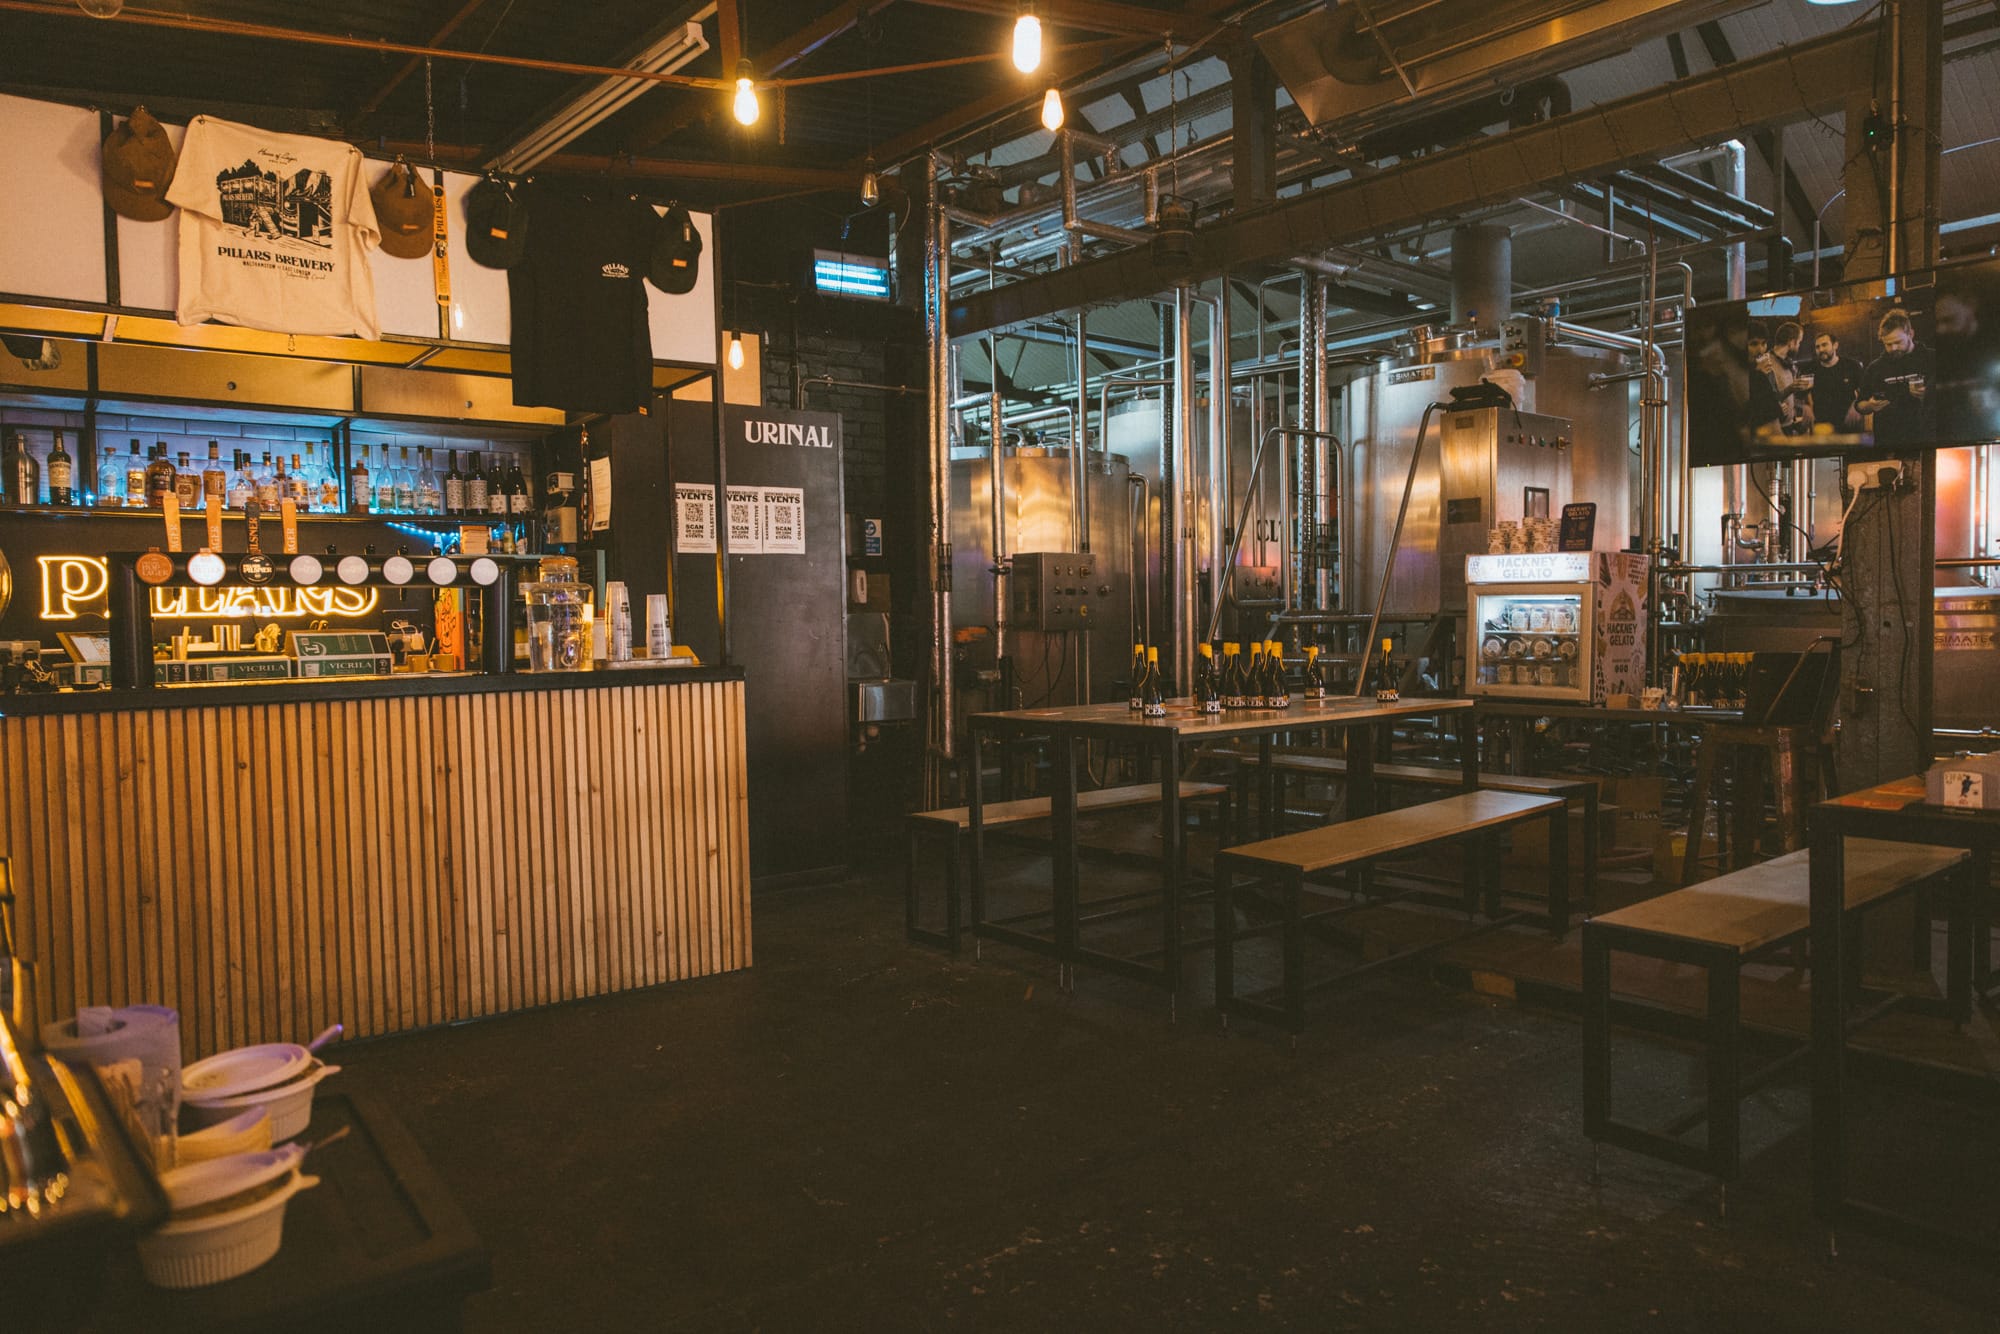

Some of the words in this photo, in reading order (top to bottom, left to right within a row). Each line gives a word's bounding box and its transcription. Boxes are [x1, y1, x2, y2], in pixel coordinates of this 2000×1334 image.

[436, 198, 444, 232] PILLARS
[217, 246, 272, 261] PILLARS
[275, 253, 335, 272] BREWERY
[744, 420, 833, 448] URINAL
[675, 491, 714, 501] EVENTS
[726, 494, 759, 503] VENTS
[764, 495, 801, 504] EVENTS
[170, 523, 180, 550] AGER
[249, 517, 258, 550] ILSNER
[1257, 520, 1281, 542] CL
[210, 525, 220, 552] AGER
[286, 528, 296, 552] AGER
[1497, 557, 1558, 569] HACKNEY
[1503, 568, 1552, 578] GELATO
[1607, 623, 1638, 634] HACKNEY
[1610, 635, 1635, 646] GELATO
[239, 664, 286, 672] VICRILA
[328, 661, 372, 669] VICRILA
